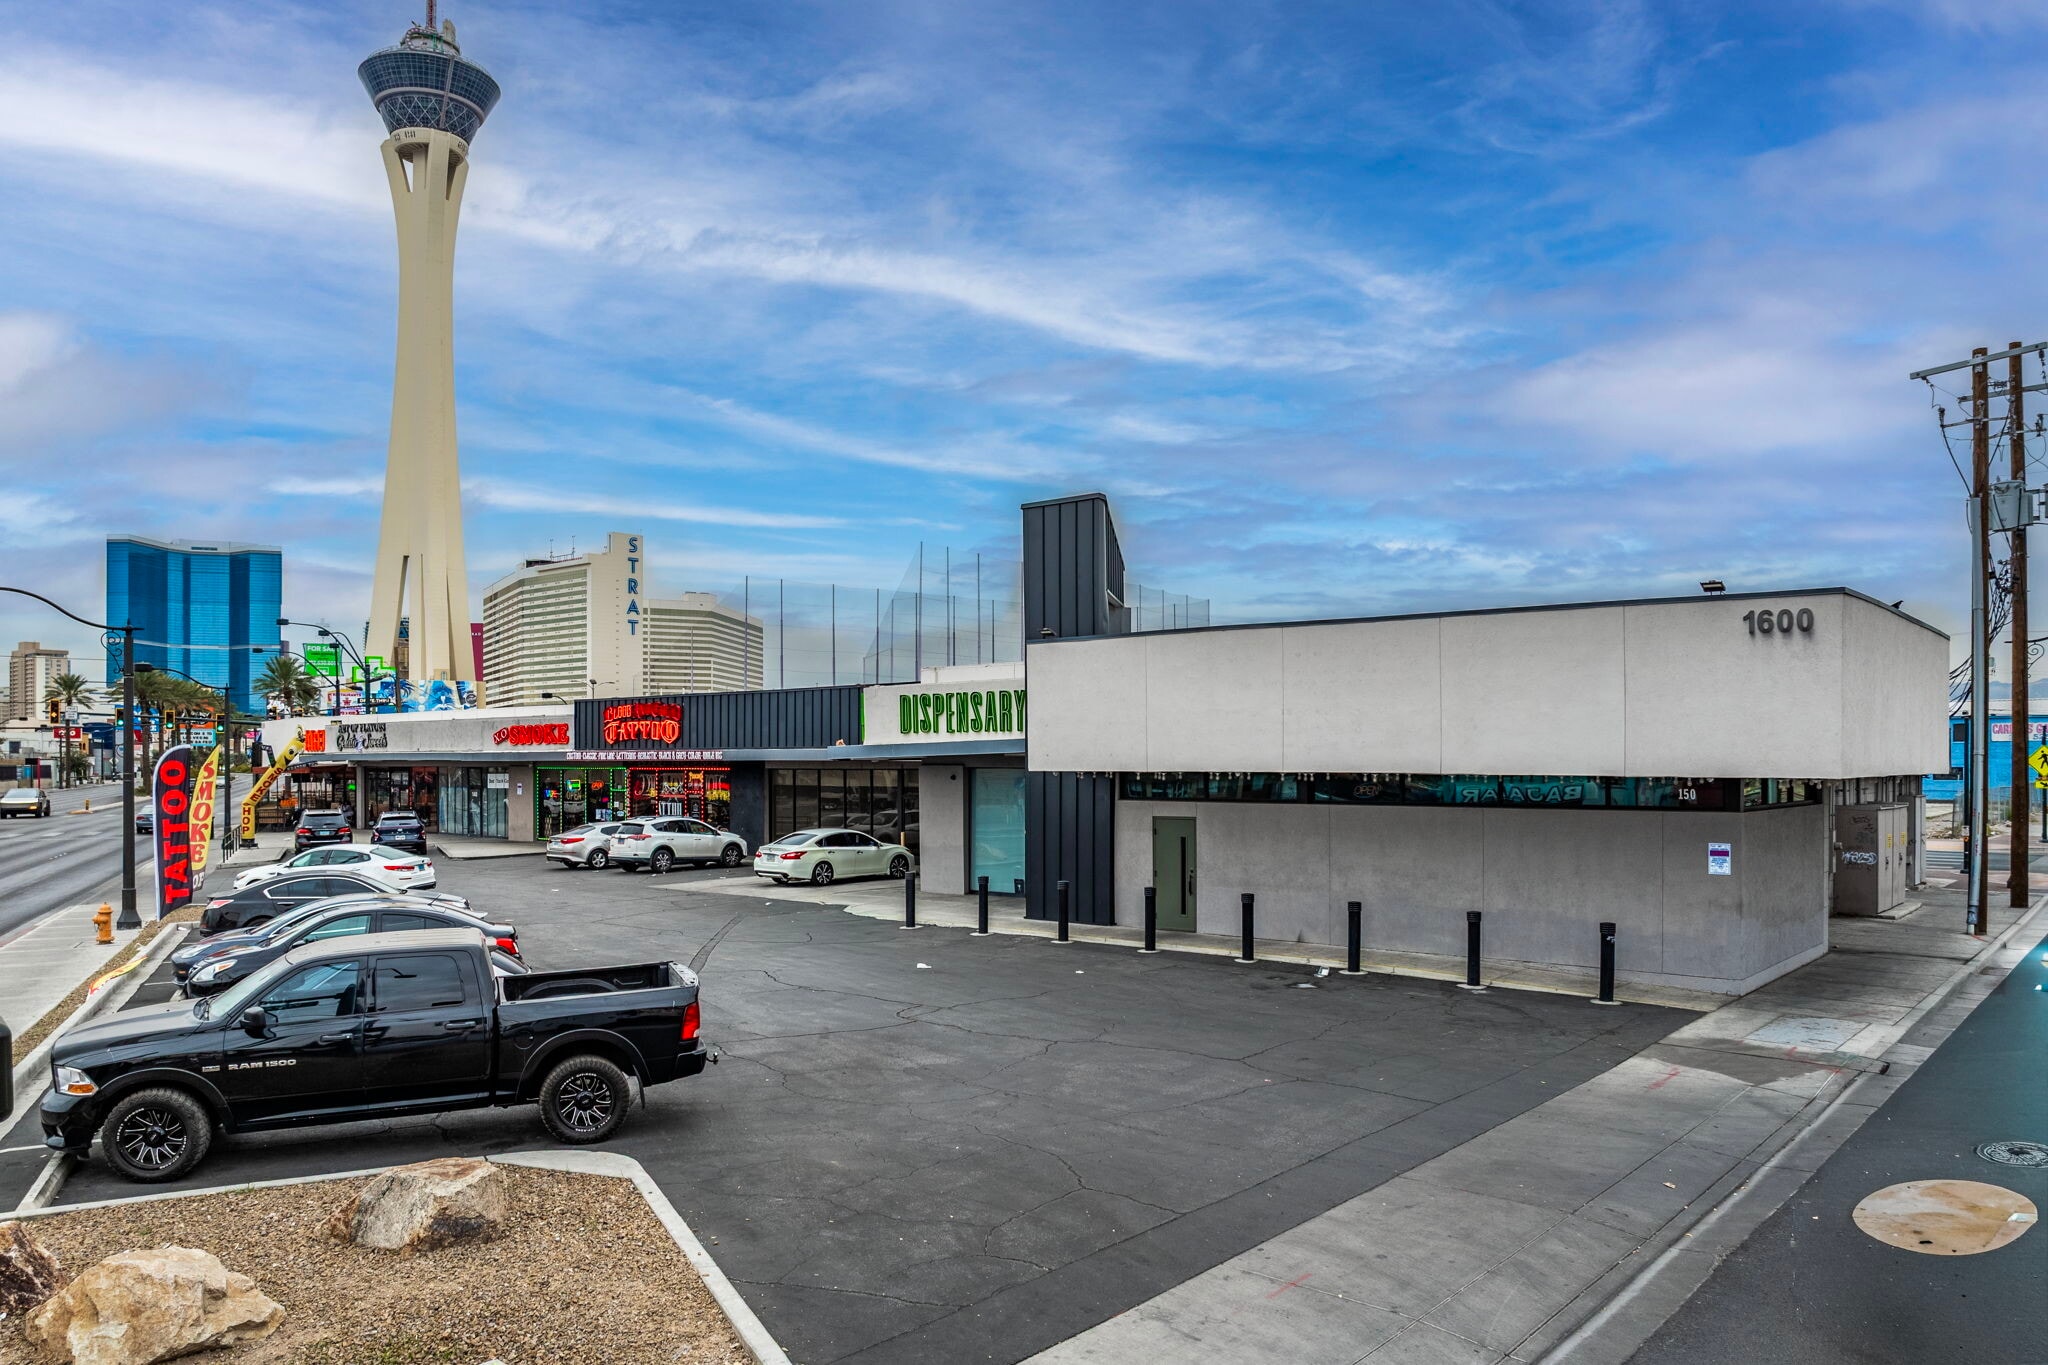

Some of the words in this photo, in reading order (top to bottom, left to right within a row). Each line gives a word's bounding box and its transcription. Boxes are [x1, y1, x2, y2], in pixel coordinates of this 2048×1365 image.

[626, 537, 640, 636] STRAT
[1743, 608, 1814, 634] 1600
[899, 690, 1026, 734] DISPENSARY
[509, 723, 570, 746] SMOKE
[603, 719, 680, 744] TATTOO
[249, 767, 284, 802] SMOKE
[1678, 788, 1696, 800] 150
[190, 760, 215, 863] SMOKE
[159, 759, 191, 904] TATTOO
[228, 1061, 263, 1071] RAM
[265, 1059, 297, 1068] 1500
